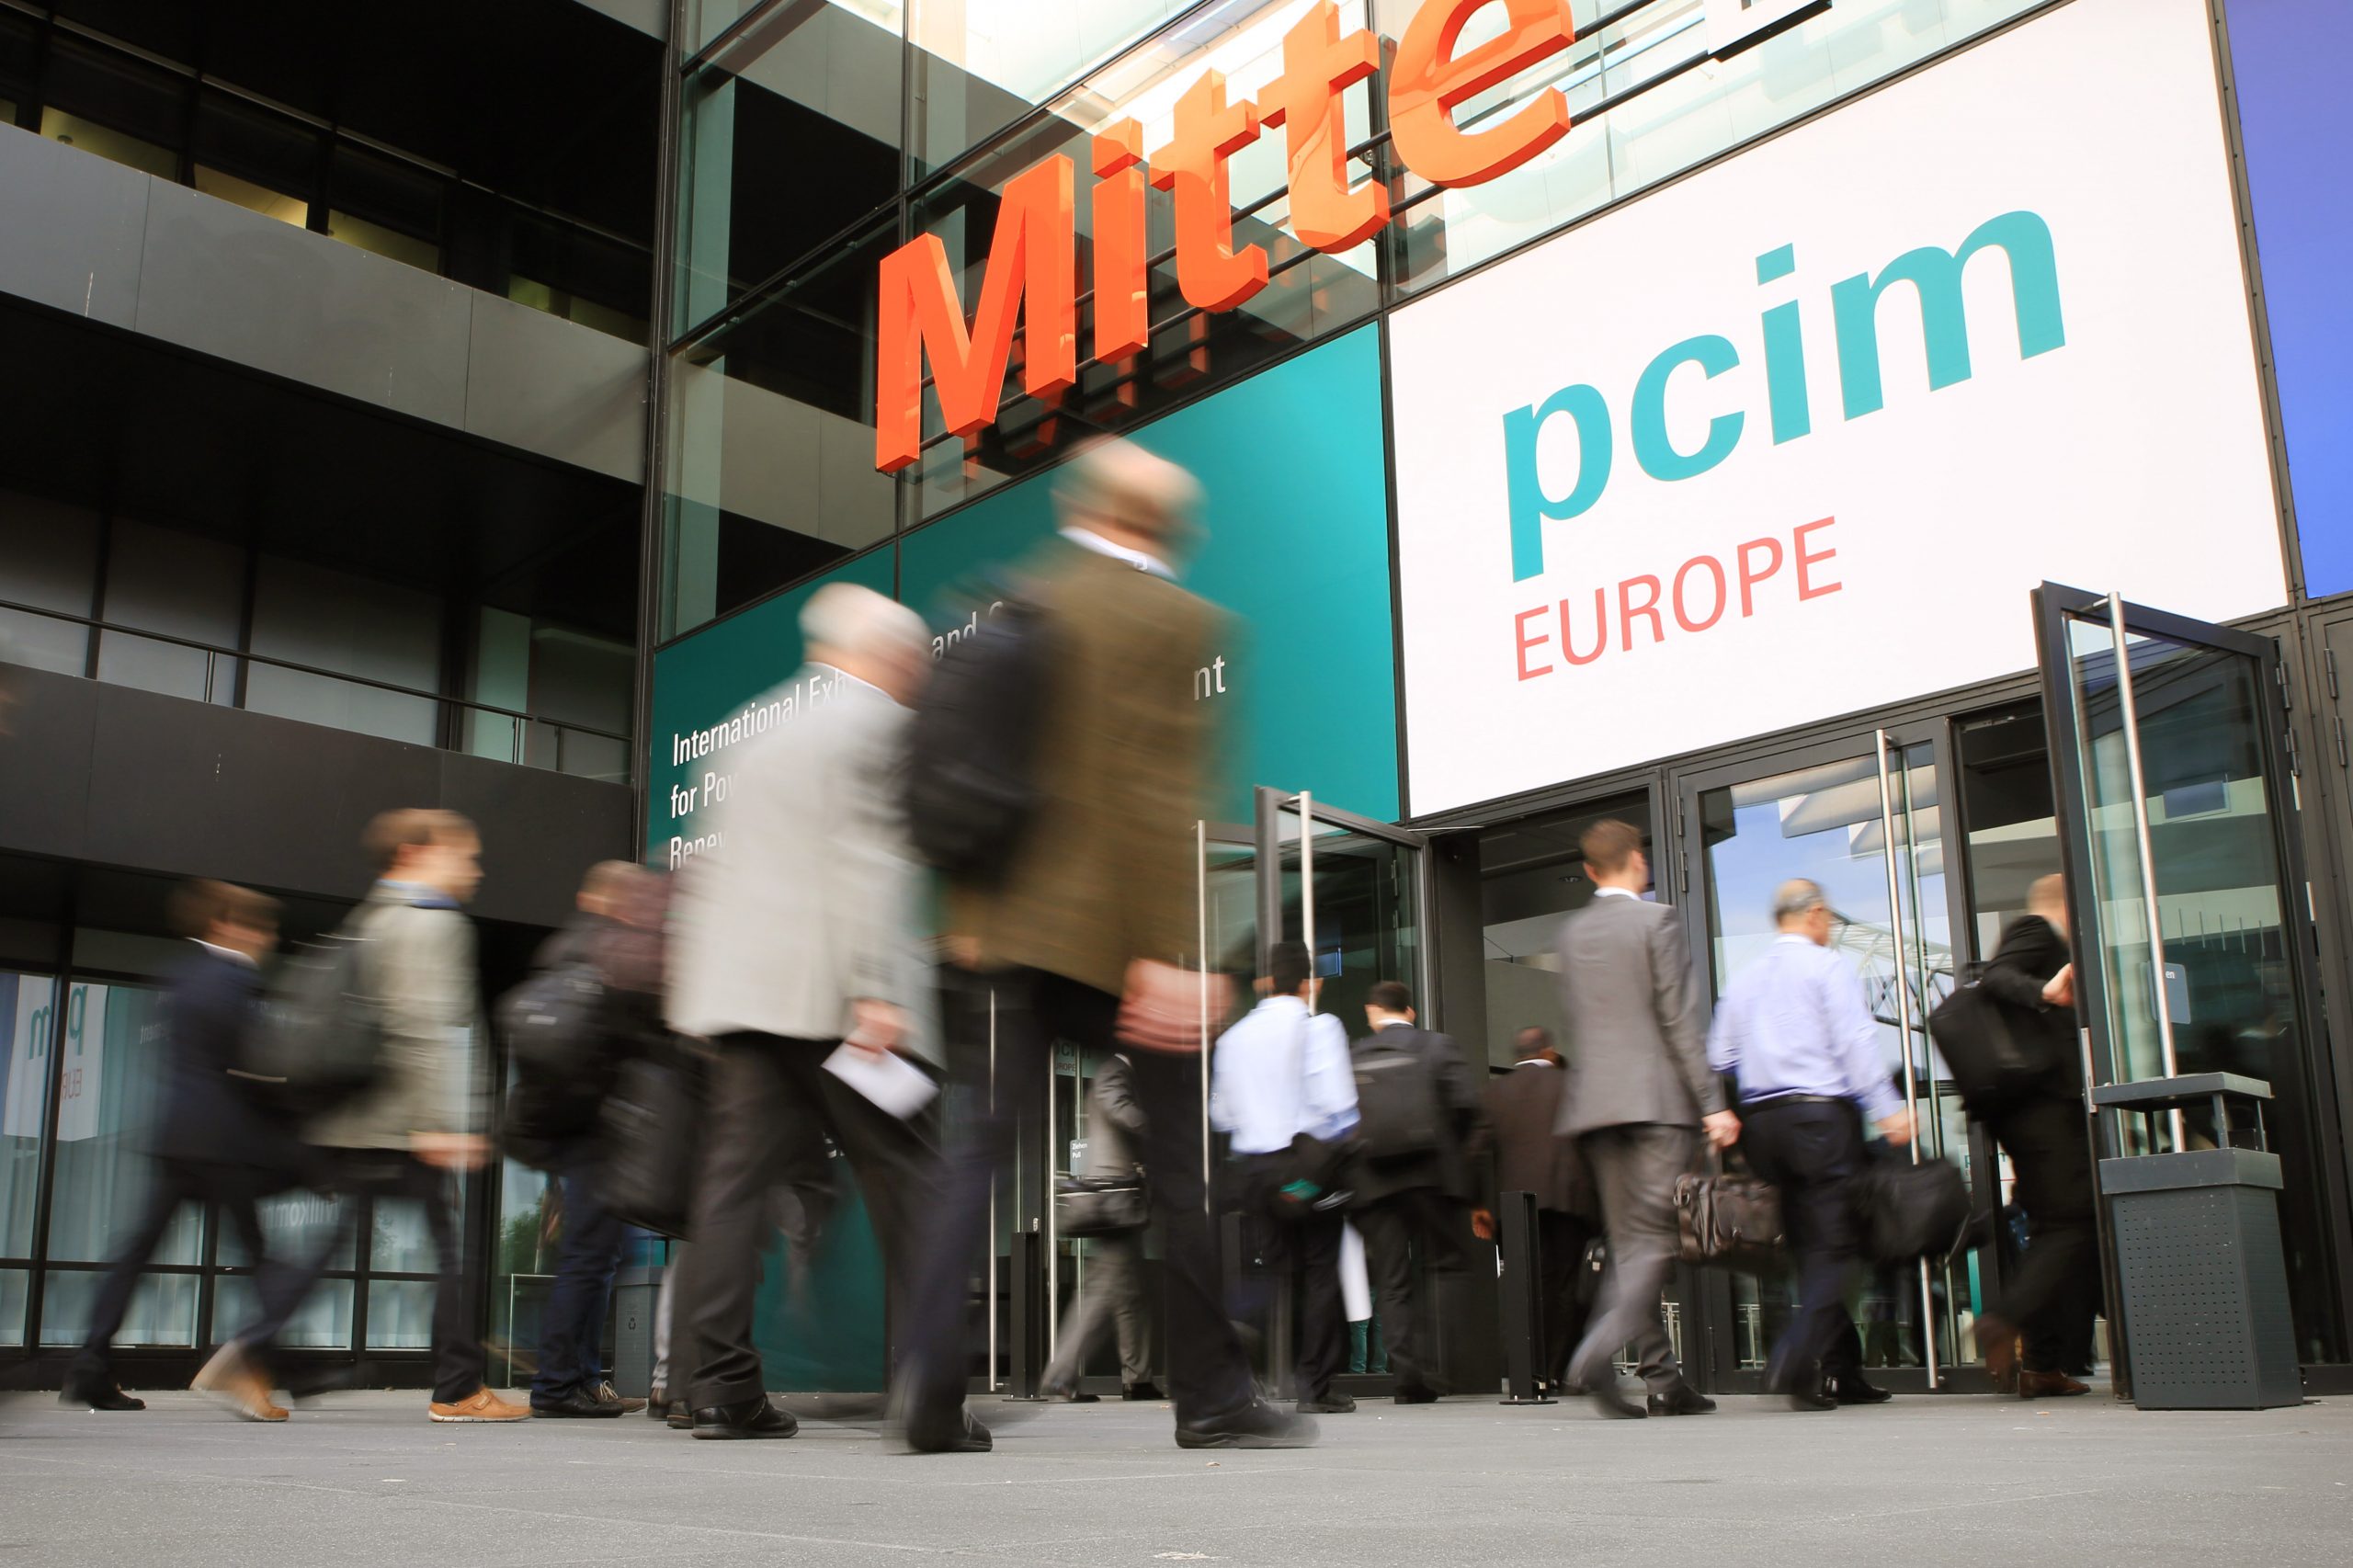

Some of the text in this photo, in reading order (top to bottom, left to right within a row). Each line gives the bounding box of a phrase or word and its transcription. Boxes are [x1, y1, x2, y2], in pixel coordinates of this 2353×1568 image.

[876, 0, 1576, 472] Mitte
[1503, 210, 2066, 583] pcim
[1514, 516, 1843, 681] EUROPE
[670, 784, 698, 819] for
[673, 683, 801, 767] International
